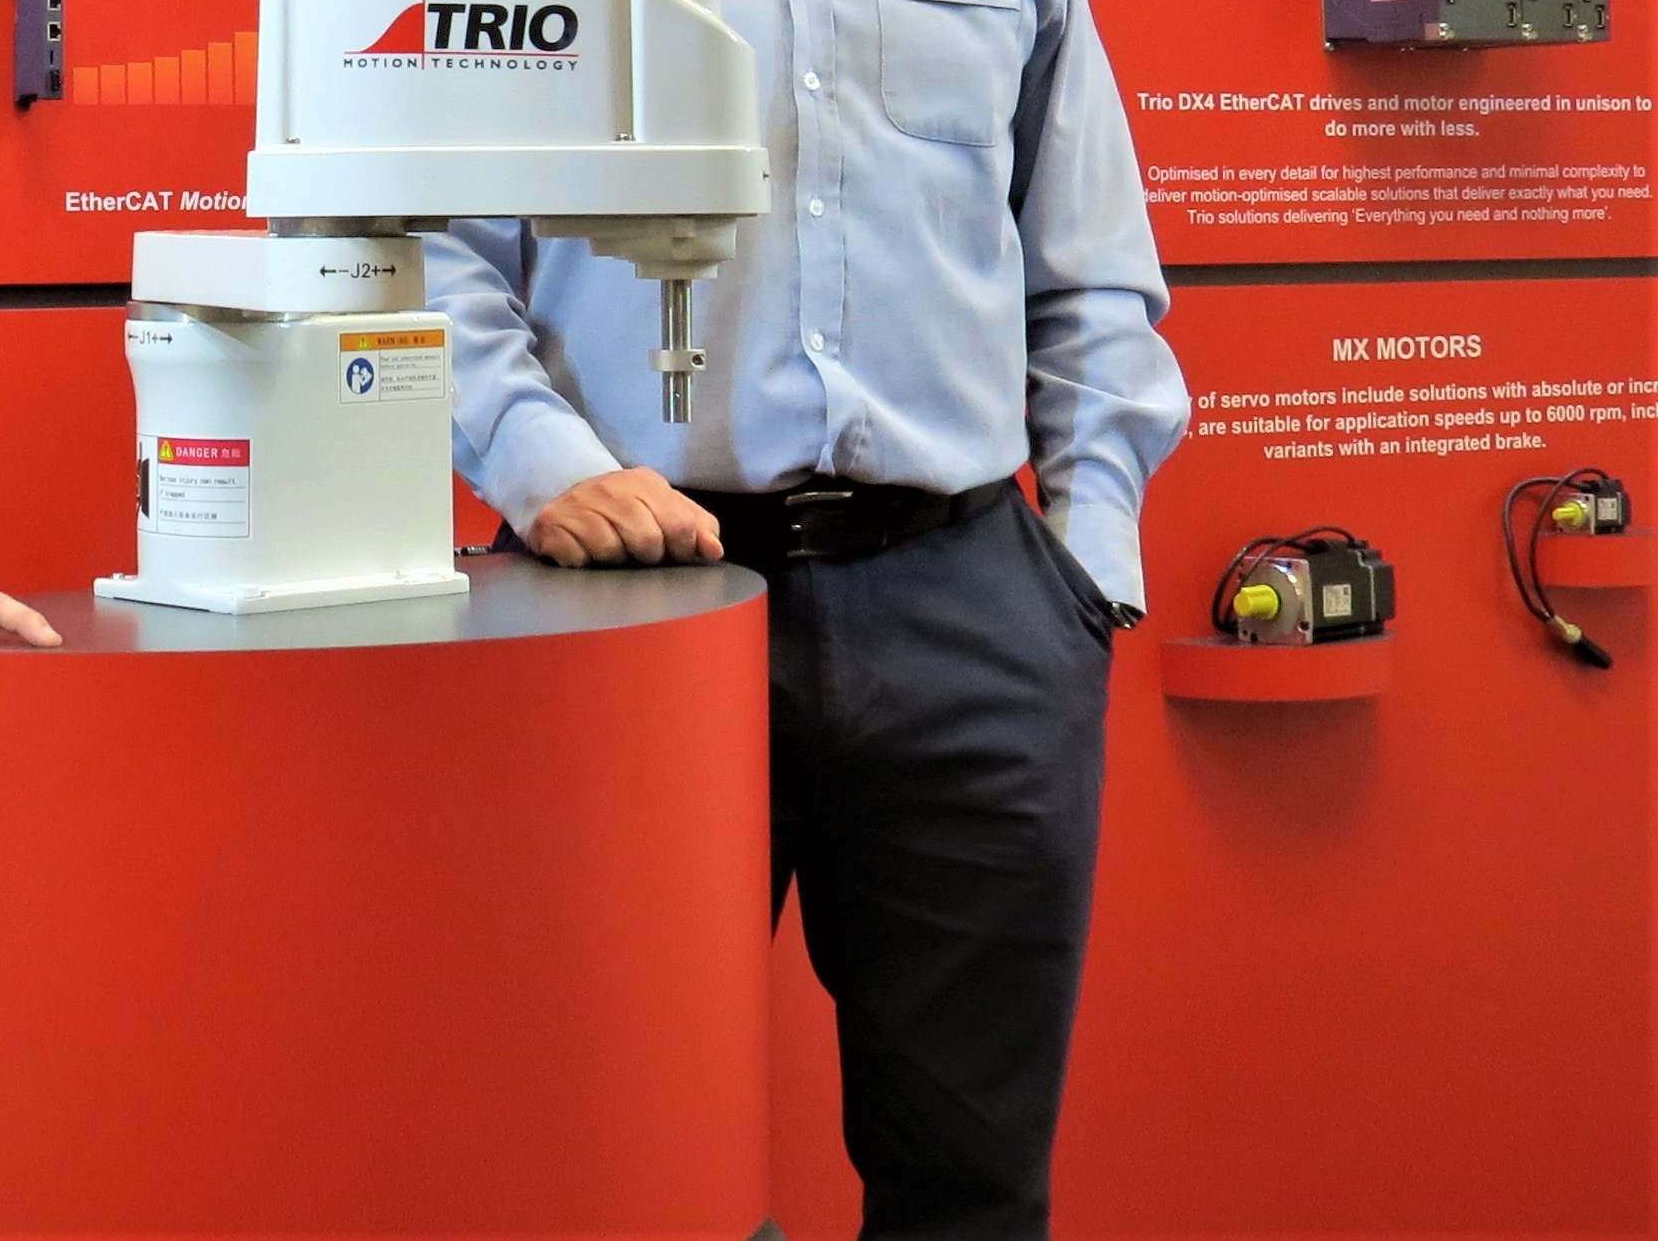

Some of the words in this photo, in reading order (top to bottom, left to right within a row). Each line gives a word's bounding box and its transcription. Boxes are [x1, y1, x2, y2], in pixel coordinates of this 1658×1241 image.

[427, 4, 579, 52] TRIO
[343, 58, 418, 69] MOTION
[431, 58, 579, 72] TECHNOLOGY
[1137, 93, 1173, 110] Trio
[1179, 93, 1214, 110] DX4
[1220, 94, 1304, 110] EtherCAT
[1310, 94, 1362, 110] drives
[1368, 95, 1399, 110] and
[1405, 96, 1453, 110] motor
[1459, 95, 1551, 114] engineered
[1556, 95, 1570, 110] in
[1576, 95, 1631, 111] unison
[1636, 96, 1652, 110] to
[1325, 120, 1347, 136] do
[1353, 124, 1395, 136] more
[1401, 120, 1435, 136] with
[1441, 120, 1479, 136] less.
[1148, 166, 1218, 184] Optimised
[1223, 166, 1234, 180] in
[1239, 169, 1276, 183] every
[1280, 166, 1317, 180] detail
[1321, 165, 1339, 179] for
[1343, 166, 1391, 183] highest
[1395, 165, 1478, 182] performance
[1481, 165, 1505, 178] and
[1509, 165, 1559, 178] minimal
[1563, 165, 1630, 180] complexity
[1633, 165, 1645, 177] to
[66, 192, 173, 211] EtherCAT
[1191, 188, 1307, 204] motion-optimised
[1312, 187, 1367, 201] scalable
[1371, 187, 1429, 200] solutions
[1434, 187, 1458, 200] that
[1462, 186, 1505, 200] deliver
[1509, 186, 1553, 203] exactly
[1557, 186, 1588, 199] what
[1591, 188, 1614, 202] you
[1618, 185, 1652, 198] need.
[1187, 210, 1214, 224] Trio
[1218, 209, 1279, 224] solutions
[1283, 209, 1348, 226] delivering
[1430, 211, 1453, 224] you
[1458, 208, 1489, 221] need
[1494, 207, 1517, 220] and
[1522, 207, 1568, 223] nothing
[1334, 339, 1369, 361] MX
[1377, 335, 1481, 359] MOTORS
[1198, 391, 1216, 408] of
[1221, 394, 1270, 408] servo
[1276, 390, 1336, 406] motors
[1342, 386, 1404, 403] include
[1410, 384, 1487, 401] solutions
[1492, 382, 1526, 398] with
[1532, 380, 1602, 397] absolute
[1607, 382, 1624, 394] or
[1199, 422, 1226, 435] are
[1232, 416, 1300, 434] suitable
[1306, 414, 1330, 431] for
[1336, 411, 1429, 434] application
[1435, 409, 1494, 429] speeds
[1500, 411, 1521, 427] up
[1526, 408, 1542, 422] to
[1547, 405, 1585, 422] 6000
[1590, 408, 1626, 424] rpm,
[175, 446, 219, 458] DANGER
[1264, 441, 1333, 458] variants
[1339, 438, 1374, 455] with
[1380, 441, 1400, 454] an
[1406, 435, 1490, 455] integrated
[1496, 432, 1546, 449] brake.
